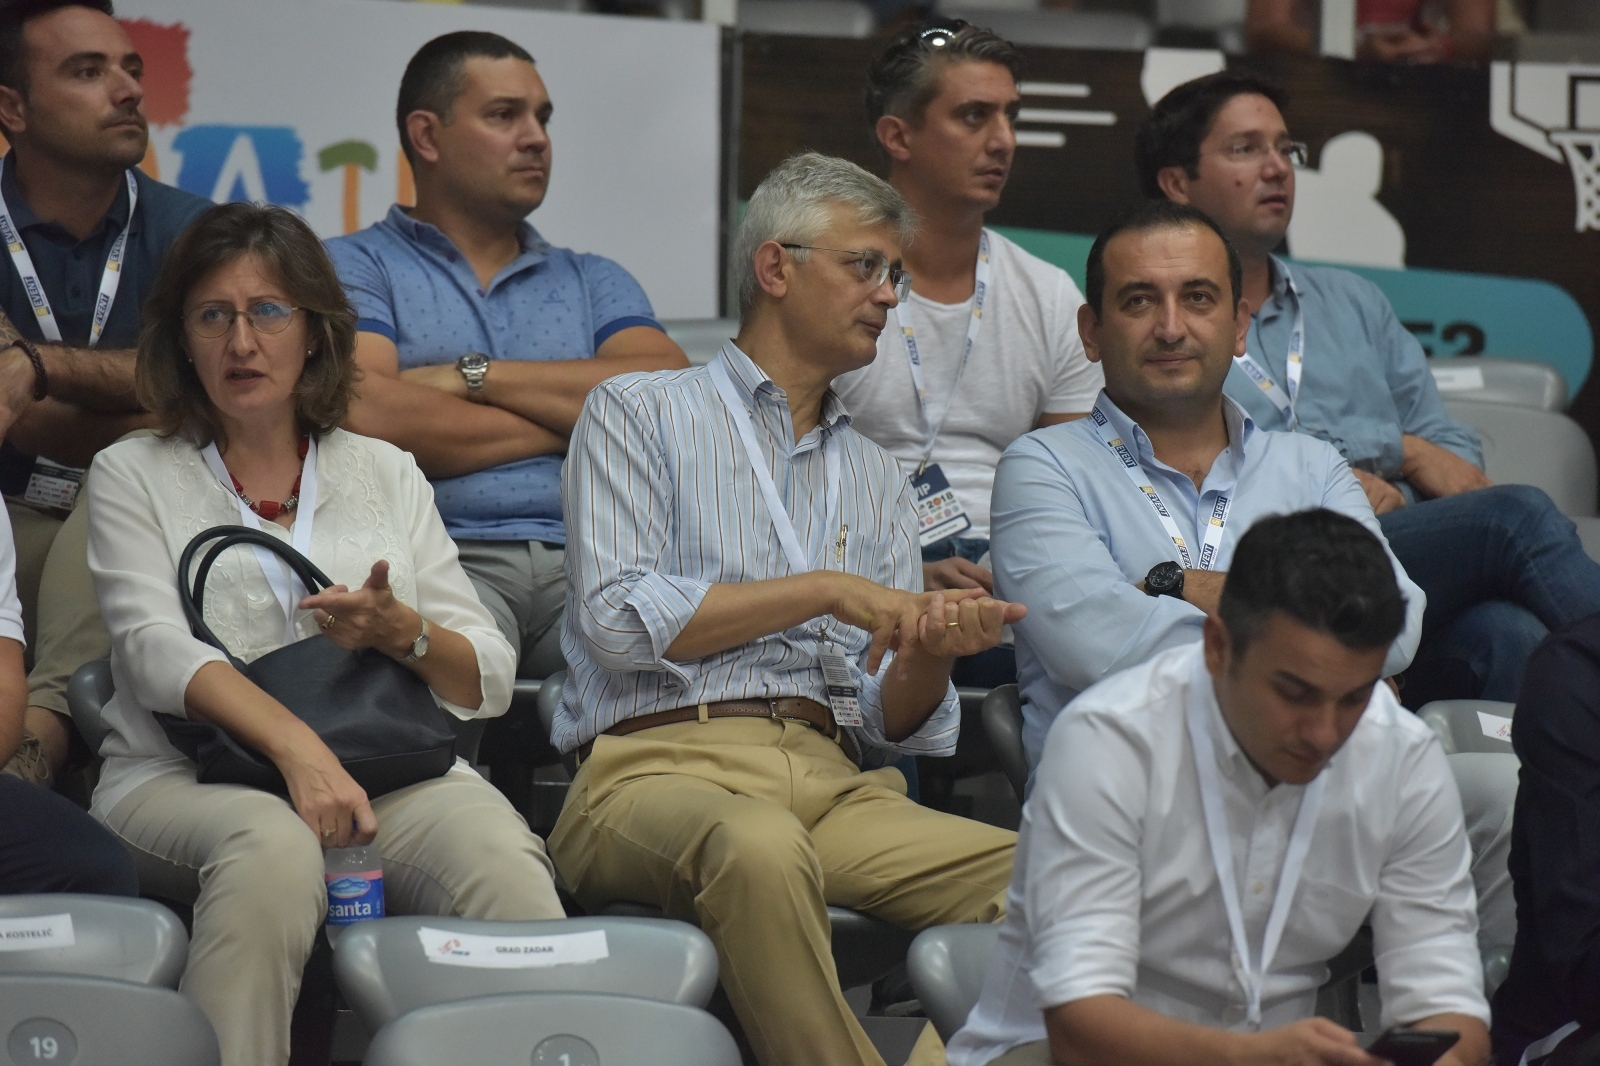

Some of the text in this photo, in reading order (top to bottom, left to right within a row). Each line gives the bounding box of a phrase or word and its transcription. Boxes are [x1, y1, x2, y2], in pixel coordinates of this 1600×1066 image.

[24, 277, 43, 306] EVENT
[1116, 445, 1137, 467] EVENT
[1149, 493, 1170, 517] EVENT
[1213, 496, 1227, 518] EVENT
[1200, 544, 1214, 571] EVENT
[329, 901, 371, 917] santa
[495, 945, 555, 955] GRAD ZADAR
[29, 1036, 58, 1059] 19
[559, 1053, 570, 1066] 1
